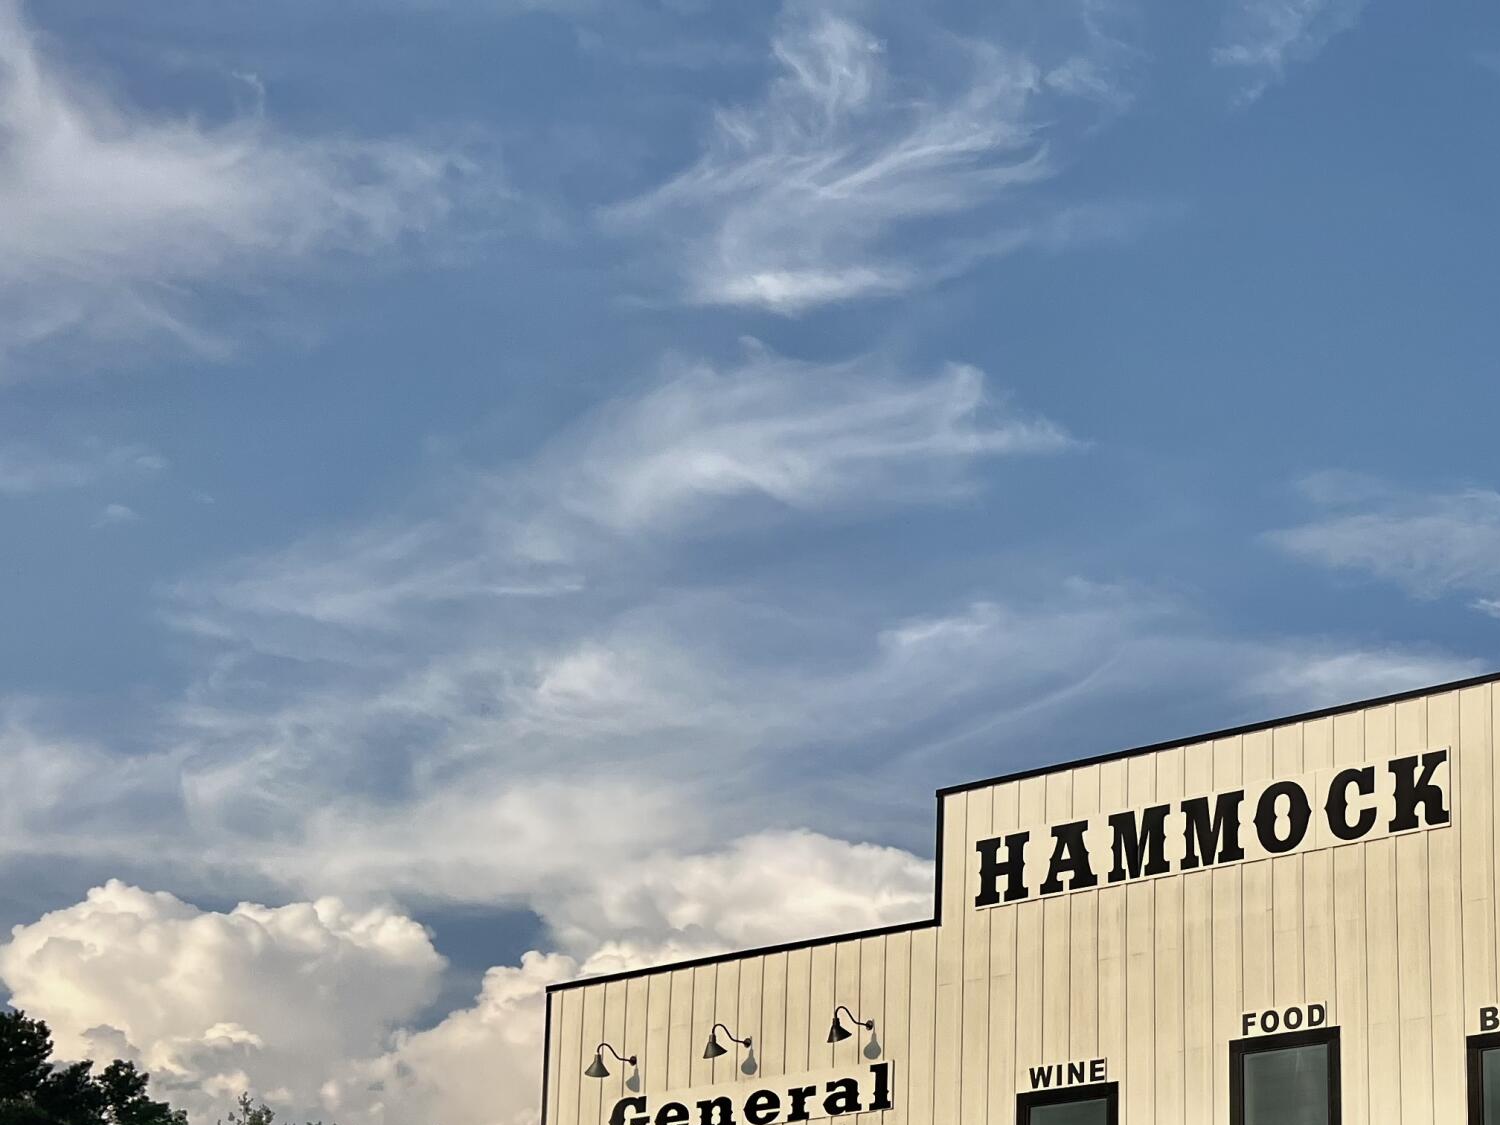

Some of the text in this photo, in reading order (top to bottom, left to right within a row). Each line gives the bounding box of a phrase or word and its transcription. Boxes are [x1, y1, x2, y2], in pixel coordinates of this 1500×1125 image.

[975, 749, 1450, 907] HAMMOCK
[1242, 1003, 1326, 1035] FOOD
[1029, 1059, 1107, 1088] WINE
